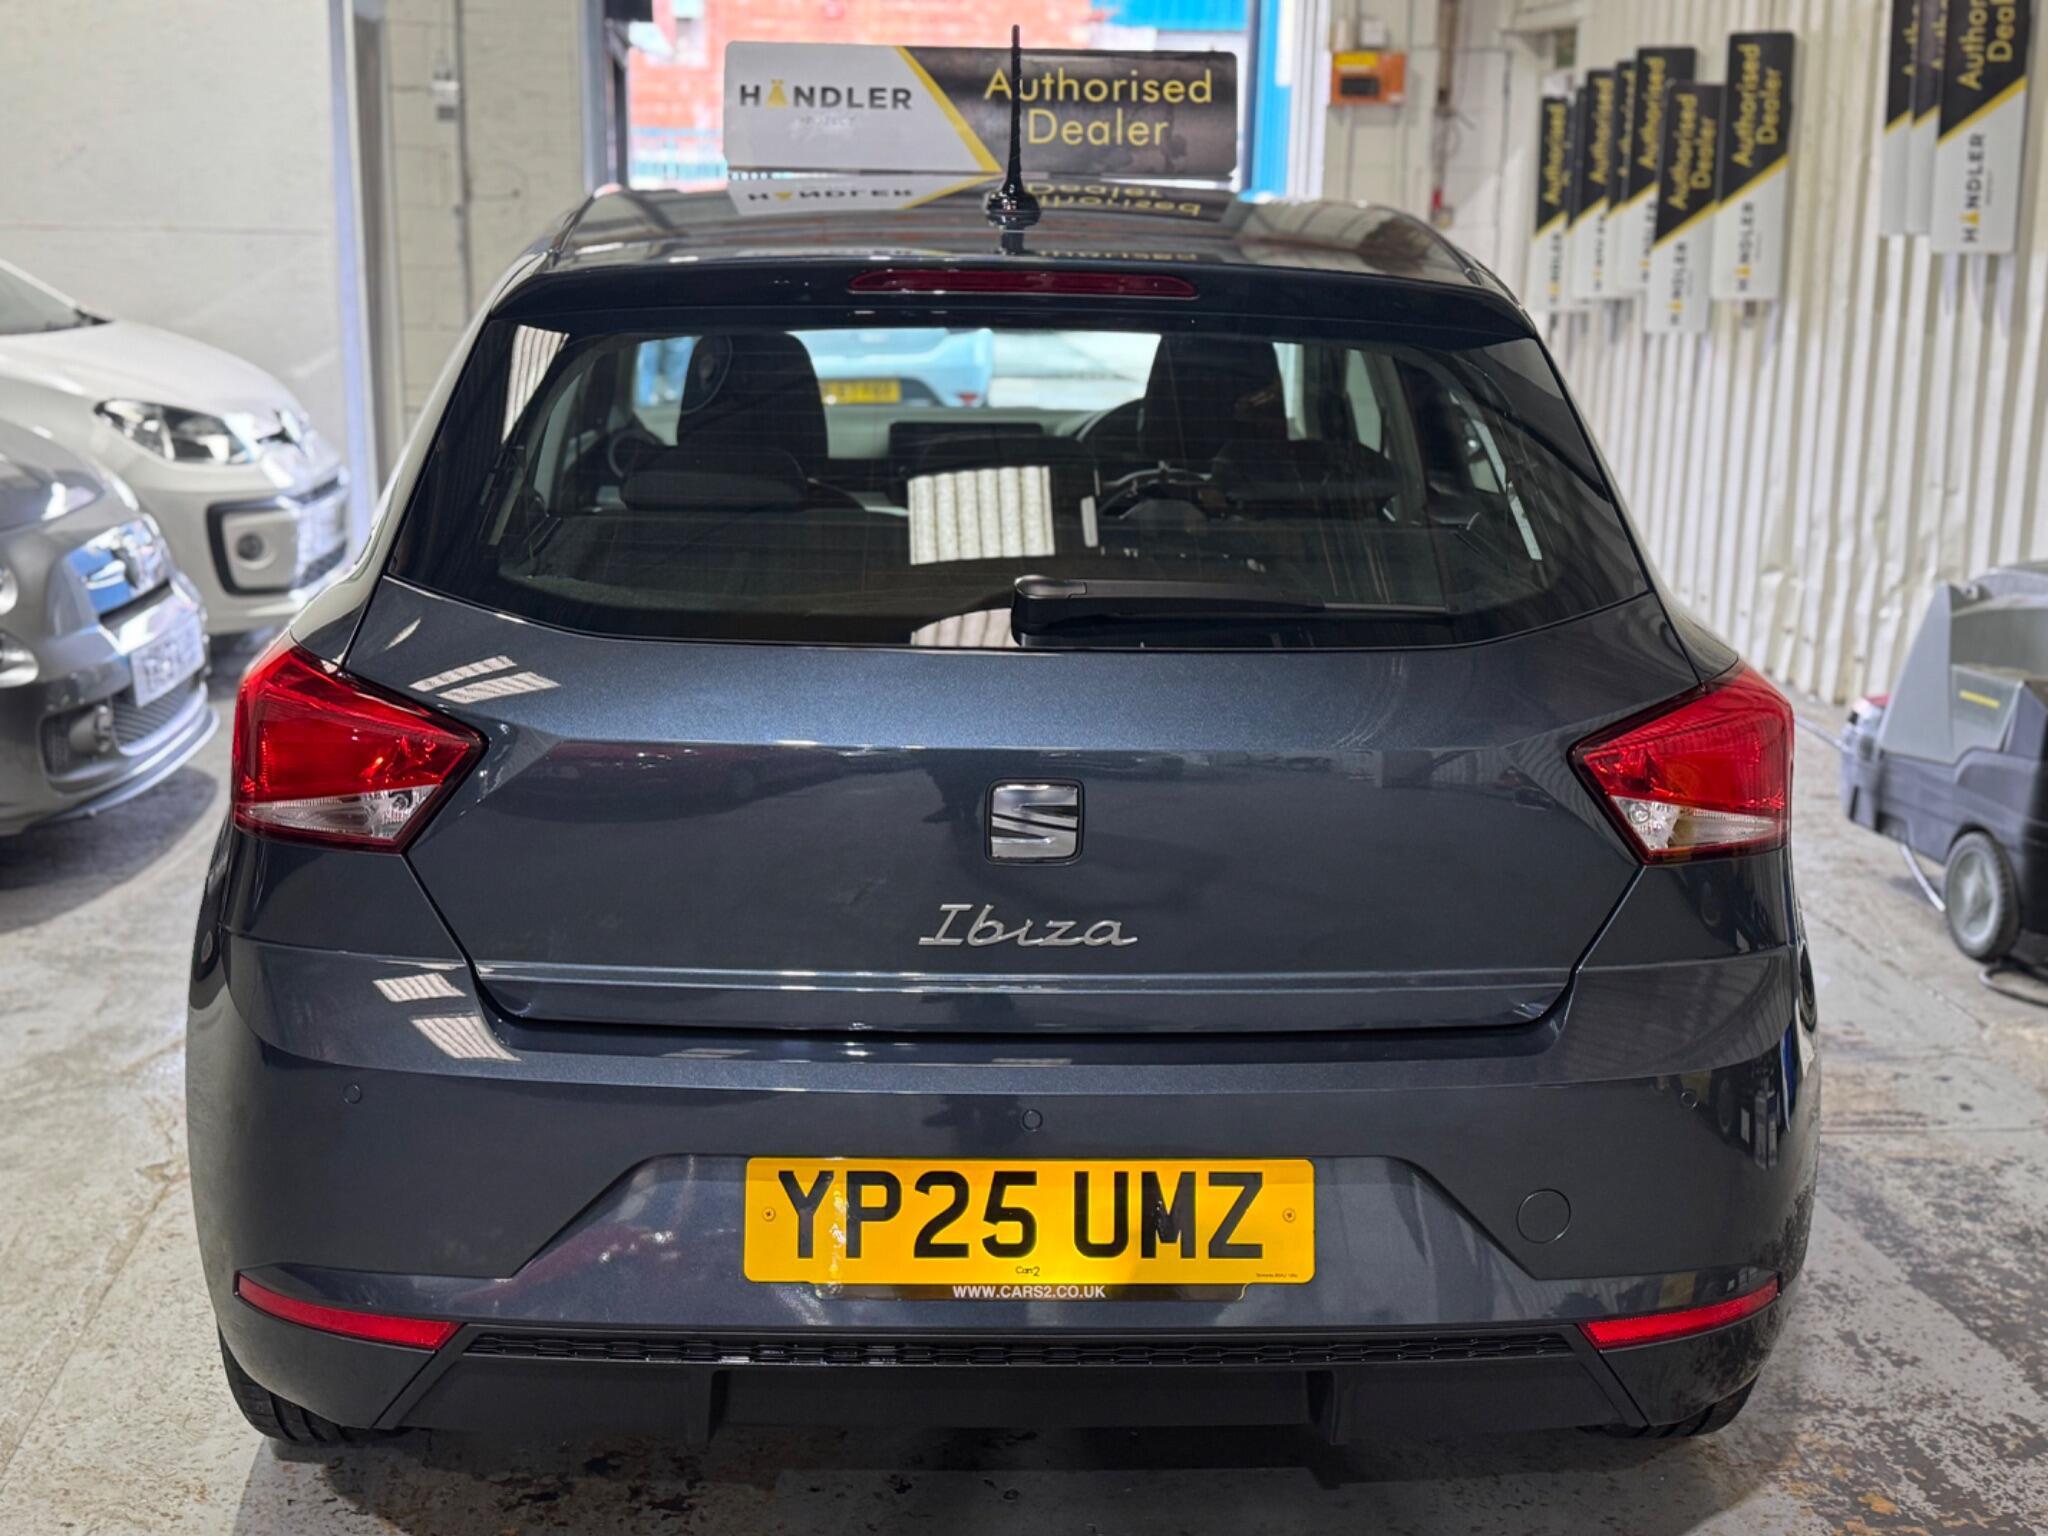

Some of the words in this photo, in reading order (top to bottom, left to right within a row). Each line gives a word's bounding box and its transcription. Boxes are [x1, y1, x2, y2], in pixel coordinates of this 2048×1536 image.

[982, 67, 1213, 103] Authorised
[1731, 43, 1761, 169] Authorised
[1756, 66, 1783, 145] Dealer
[1028, 107, 1170, 146] Dealer
[1667, 93, 1698, 212] Authorised
[1689, 115, 1717, 191] Dealer
[918, 903, 1139, 947] Ibiza
[778, 1170, 1038, 1259] YP25
[1073, 1171, 1263, 1259] UMZ
[952, 1285, 1106, 1299] WWW.CARS2.CO.UK
